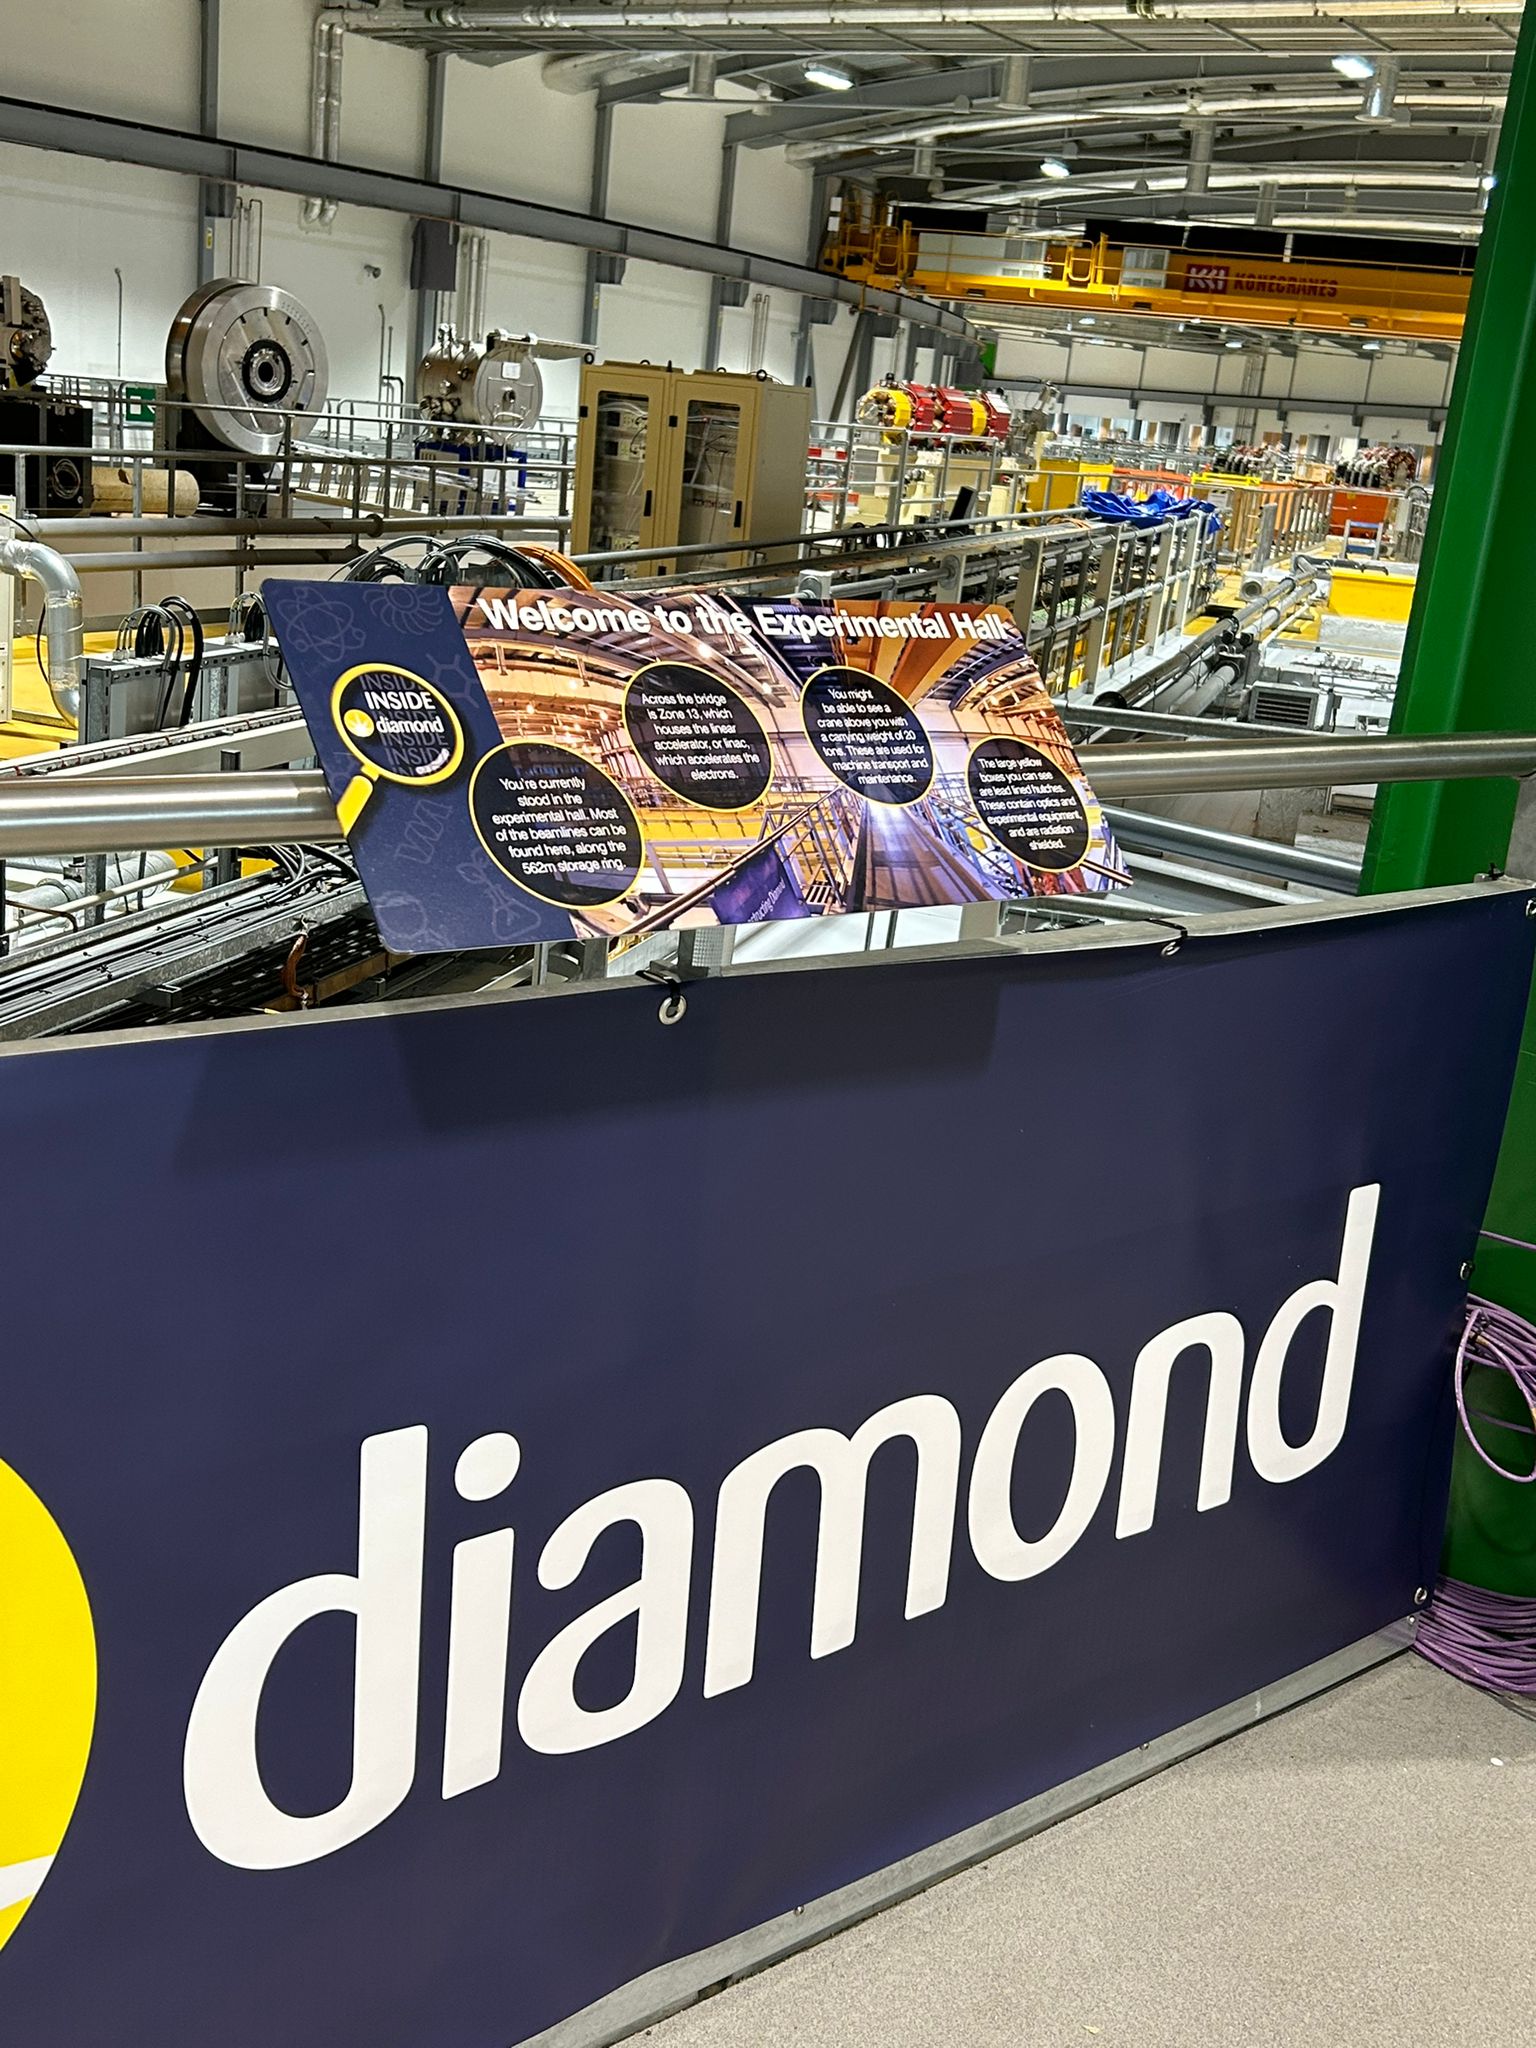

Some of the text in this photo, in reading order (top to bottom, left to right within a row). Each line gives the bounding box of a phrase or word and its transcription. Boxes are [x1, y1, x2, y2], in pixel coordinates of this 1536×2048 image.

[1233, 272, 1339, 297] KONECRANES
[476, 598, 1007, 643] Welcome to the Experimental Hall
[364, 691, 436, 710] INSIDE
[641, 693, 727, 707] Across the bridge
[828, 689, 874, 701] You might
[647, 708, 733, 721] is Zone 13, which
[821, 703, 892, 714] be able to see a
[376, 715, 444, 733] diamond
[653, 723, 736, 735] houses the linear
[817, 716, 908, 729] crane above you with
[820, 729, 916, 744] a carrying weight of 20
[654, 738, 751, 750] accelerator, or linac,
[822, 744, 925, 757] tons. These are used for
[655, 752, 760, 766] which accelerates the
[833, 758, 928, 771] machine transport and
[977, 757, 1043, 770] The large yellow
[690, 769, 739, 781] electrons.
[857, 773, 917, 784] maintenance.
[979, 771, 1053, 783] boxes you can see
[499, 776, 586, 791] You're currently
[979, 784, 1066, 797] are lead lined hutches.
[517, 793, 583, 807] stood in the
[978, 796, 1077, 810] These contain optics and
[492, 808, 619, 826] experimental hall. Most
[987, 810, 1082, 826] experimental equipment,
[495, 824, 627, 842] of the beamlines can be
[1008, 825, 1074, 837] and are radiation
[508, 841, 627, 858] found here, along the
[1029, 839, 1066, 851] shielded.
[521, 857, 626, 875] 562m storage ring.
[182, 1182, 1381, 1871] diamond
